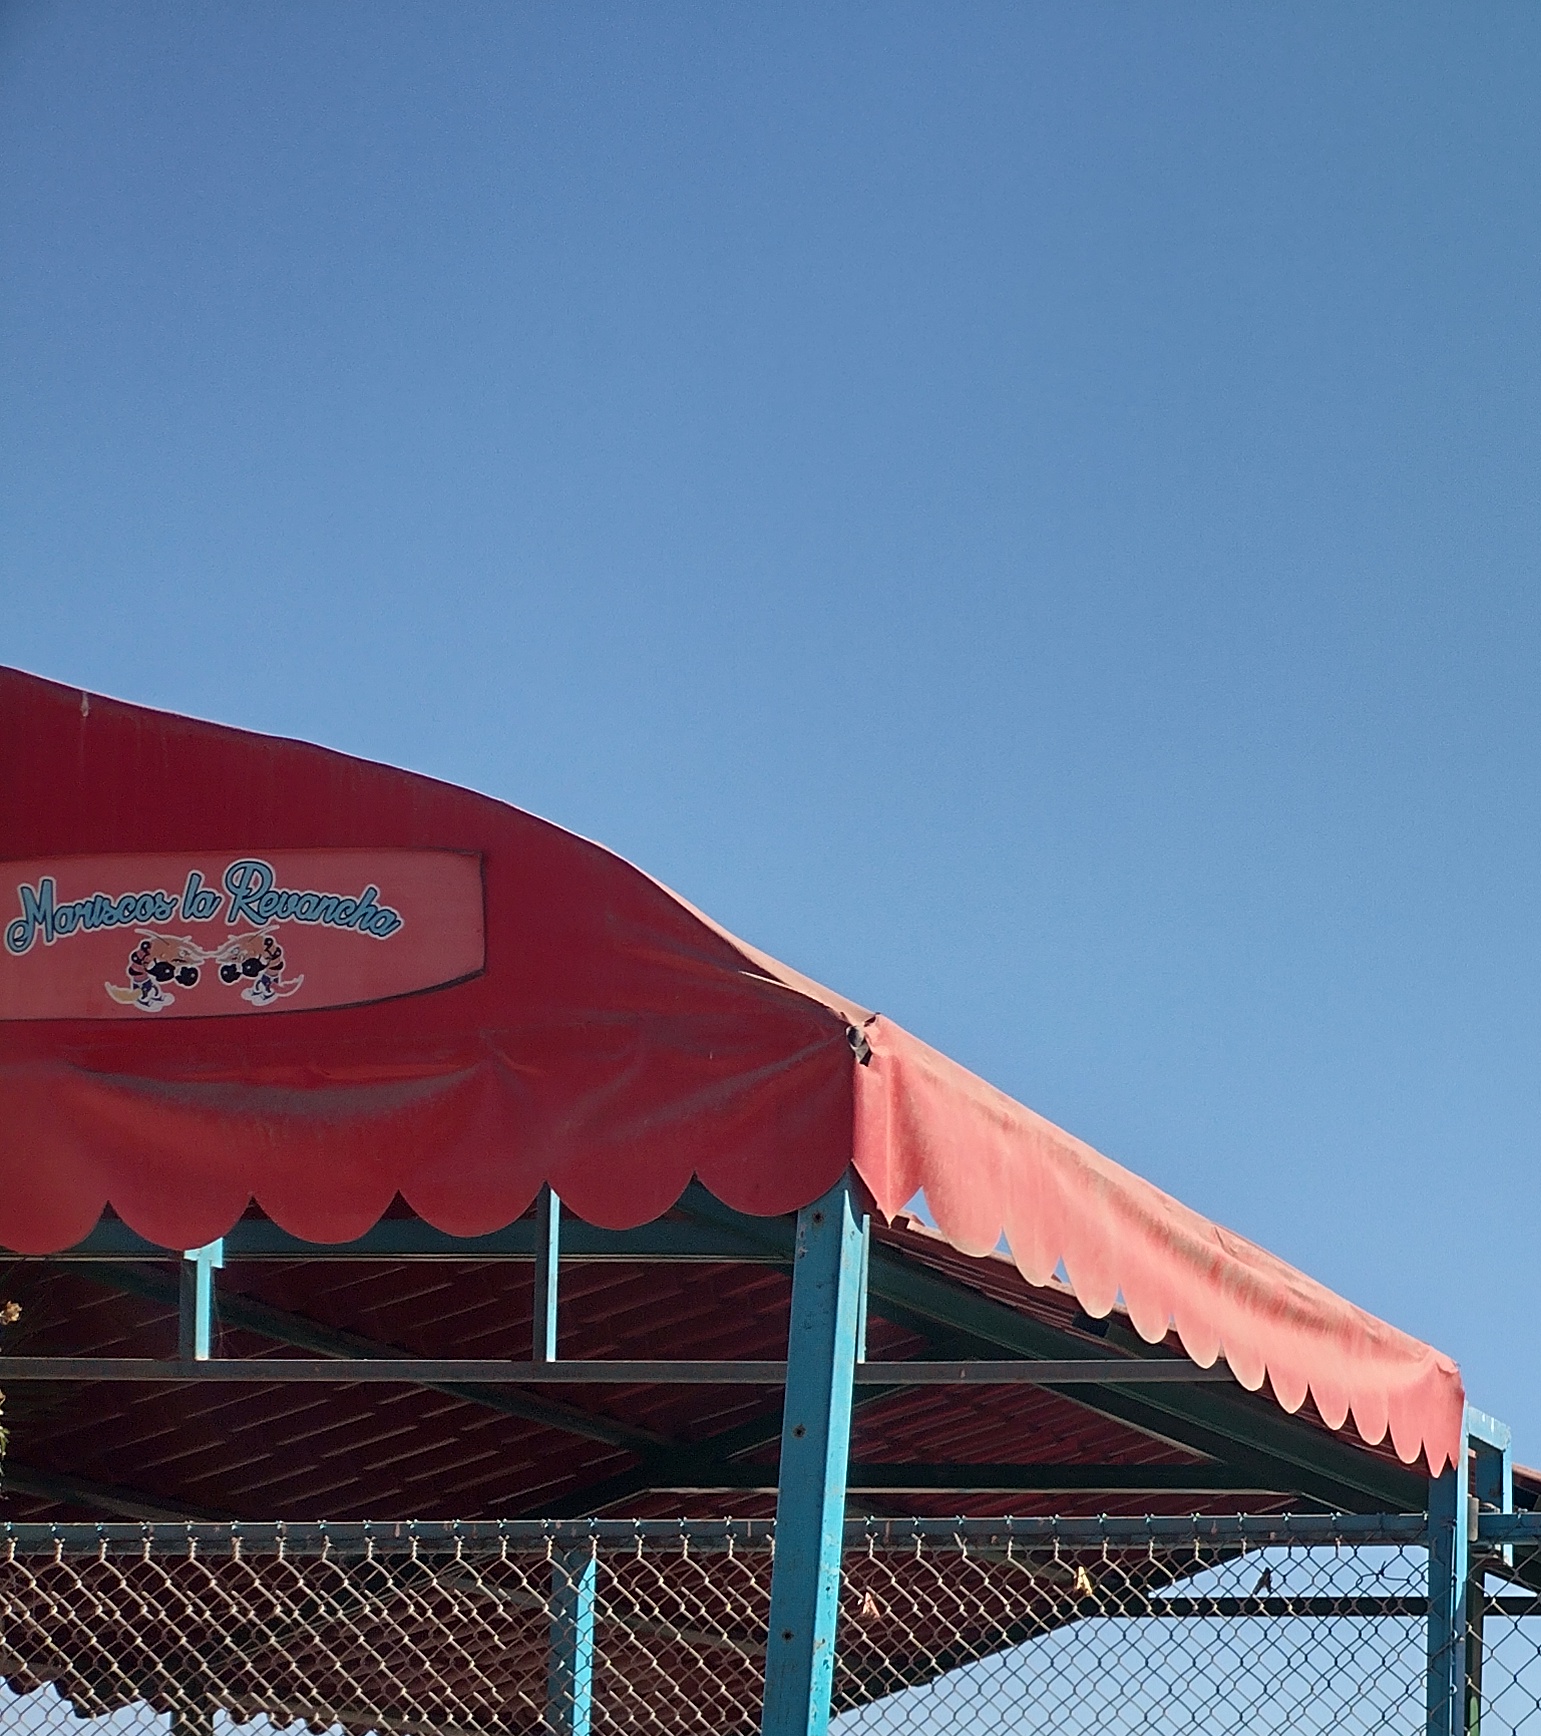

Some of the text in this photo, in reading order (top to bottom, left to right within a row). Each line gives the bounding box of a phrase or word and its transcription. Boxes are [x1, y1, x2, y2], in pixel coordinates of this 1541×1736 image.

[7, 860, 402, 954] Mariscos la Revancha
